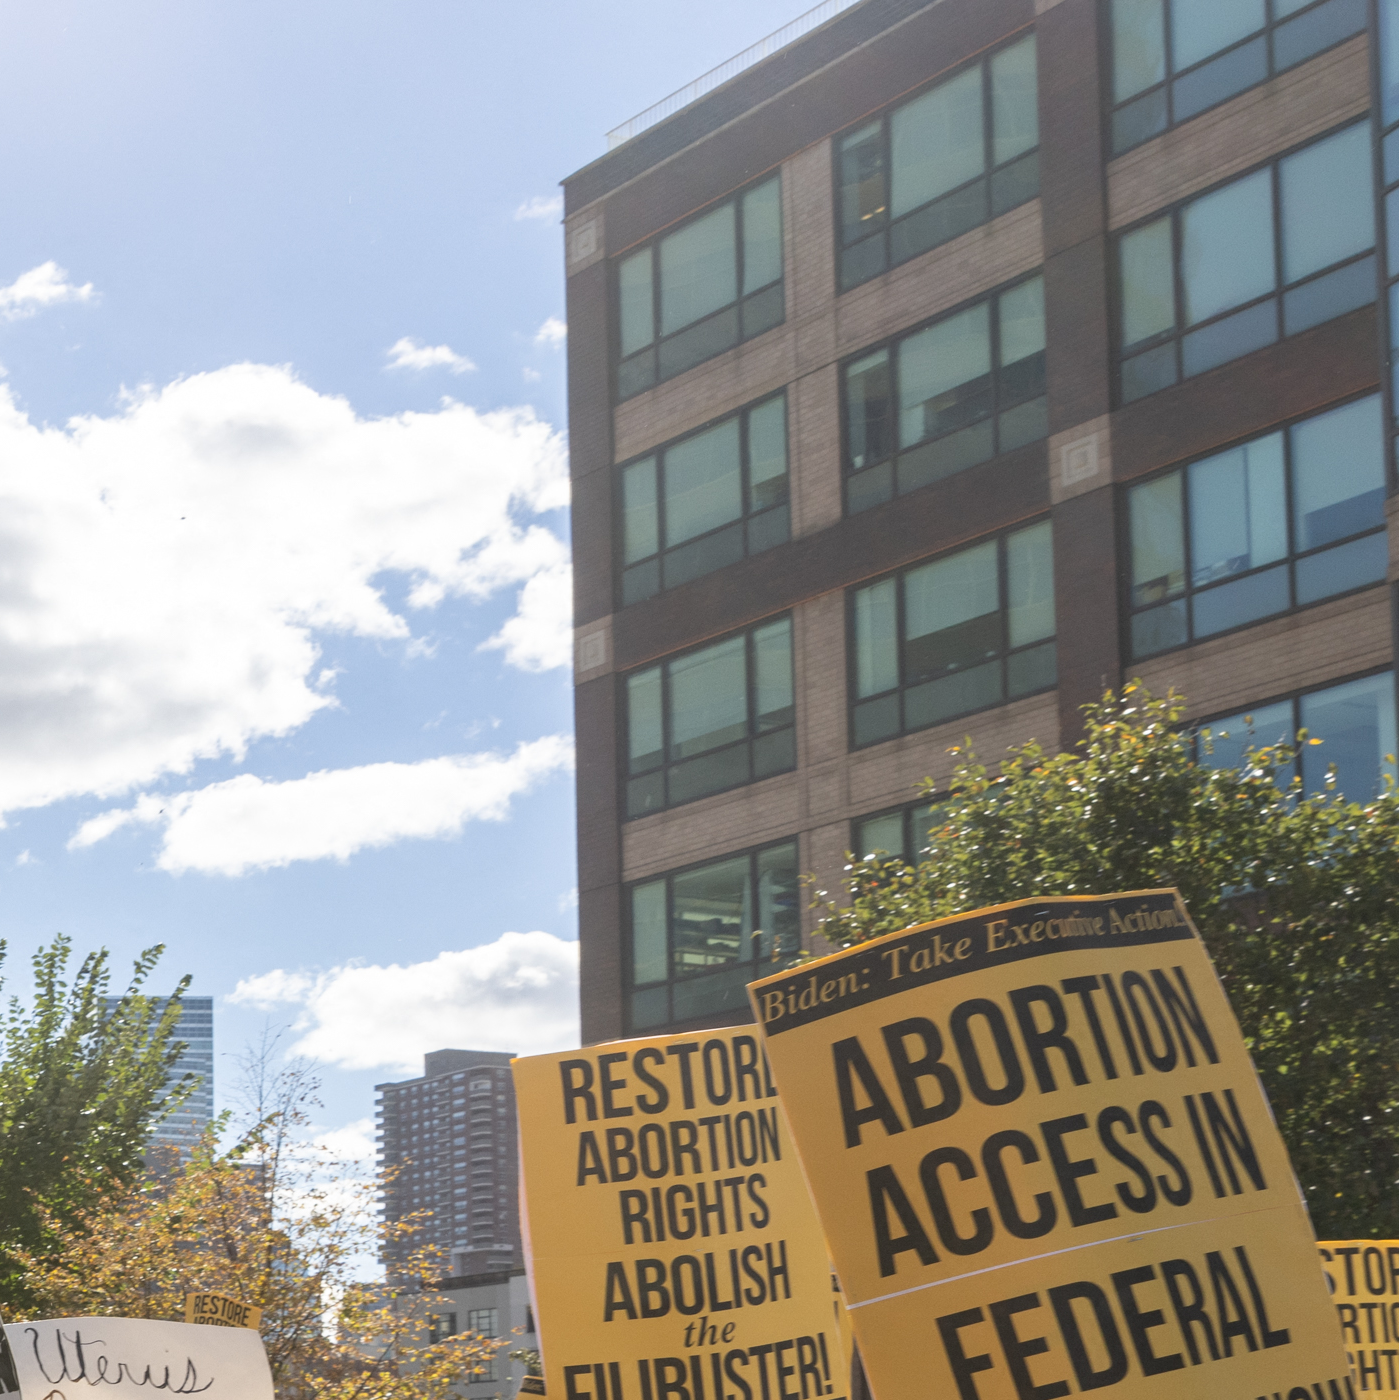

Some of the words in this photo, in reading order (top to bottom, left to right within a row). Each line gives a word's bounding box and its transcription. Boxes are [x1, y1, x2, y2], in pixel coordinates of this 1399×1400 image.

[763, 968, 872, 1026] Biden:
[882, 931, 973, 979] Take
[985, 908, 1106, 955] Executive
[829, 965, 1222, 1150] ABORTION
[576, 1106, 782, 1187] ABORTION
[864, 1099, 1196, 1279] ACCESS
[1189, 1088, 1269, 1200] IN
[618, 1172, 771, 1245] RIGHTS
[193, 1294, 251, 1327] RESTORE
[603, 1240, 793, 1323] ABOLISH
[24, 1326, 215, 1395] Uterus
[683, 1316, 737, 1348] the
